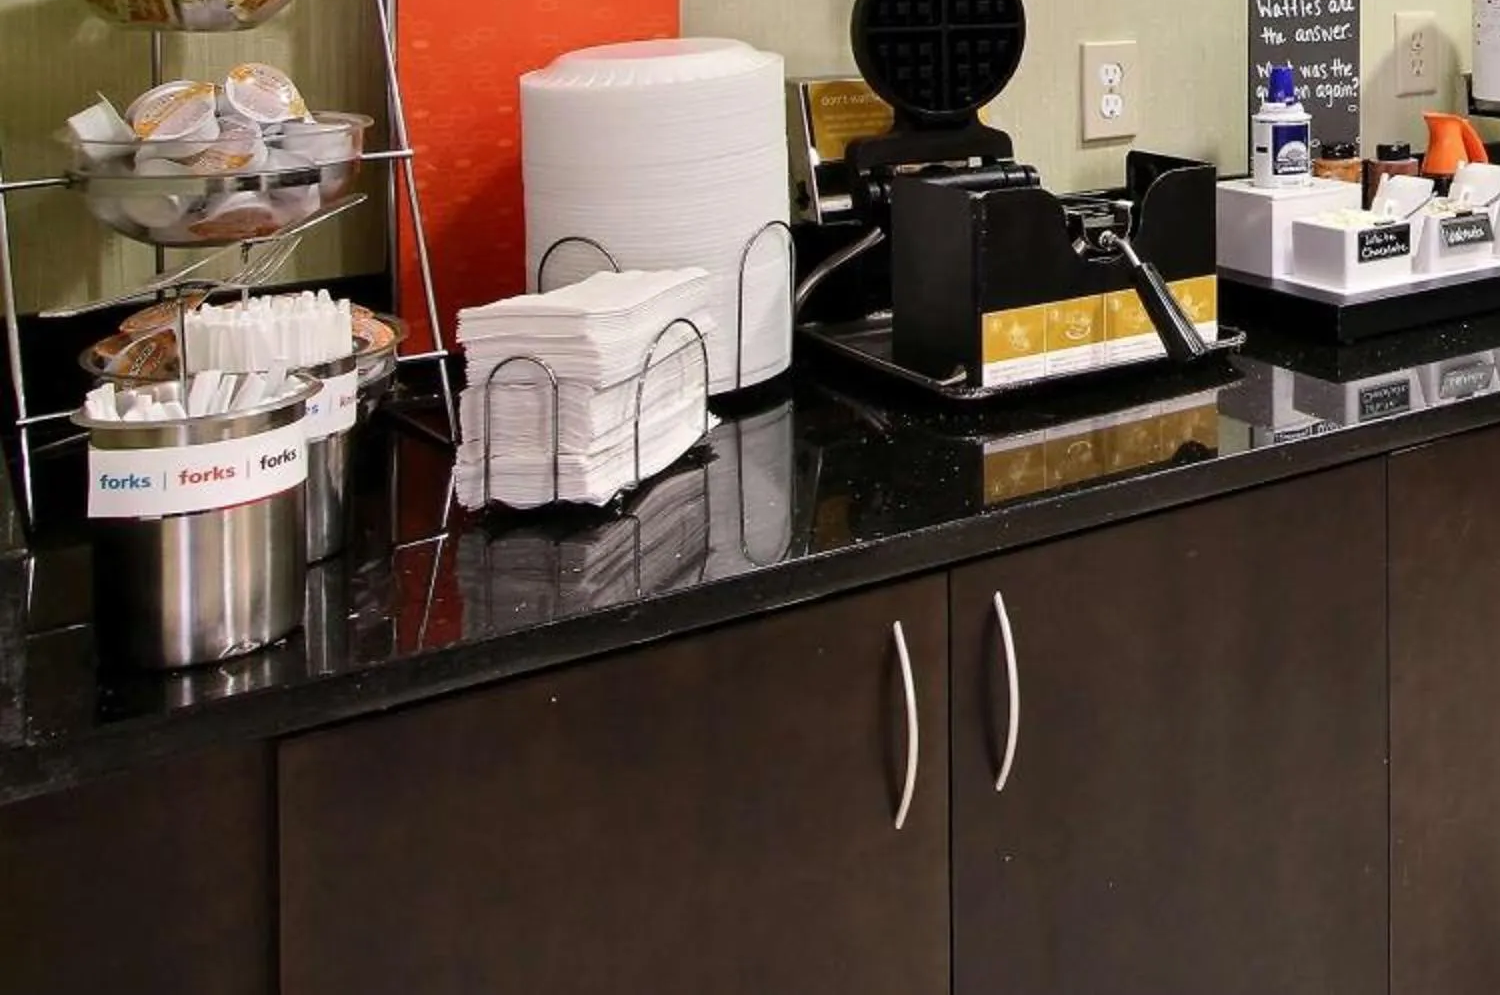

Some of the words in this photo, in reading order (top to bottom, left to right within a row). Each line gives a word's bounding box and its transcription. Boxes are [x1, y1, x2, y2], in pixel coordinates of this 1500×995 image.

[1260, 26, 1286, 45] the
[1299, 63, 1328, 80] was
[1330, 58, 1352, 77] the
[1315, 76, 1359, 108] again?
[99, 473, 151, 490] forks
[178, 464, 237, 487] forks
[259, 446, 297, 471] forks
